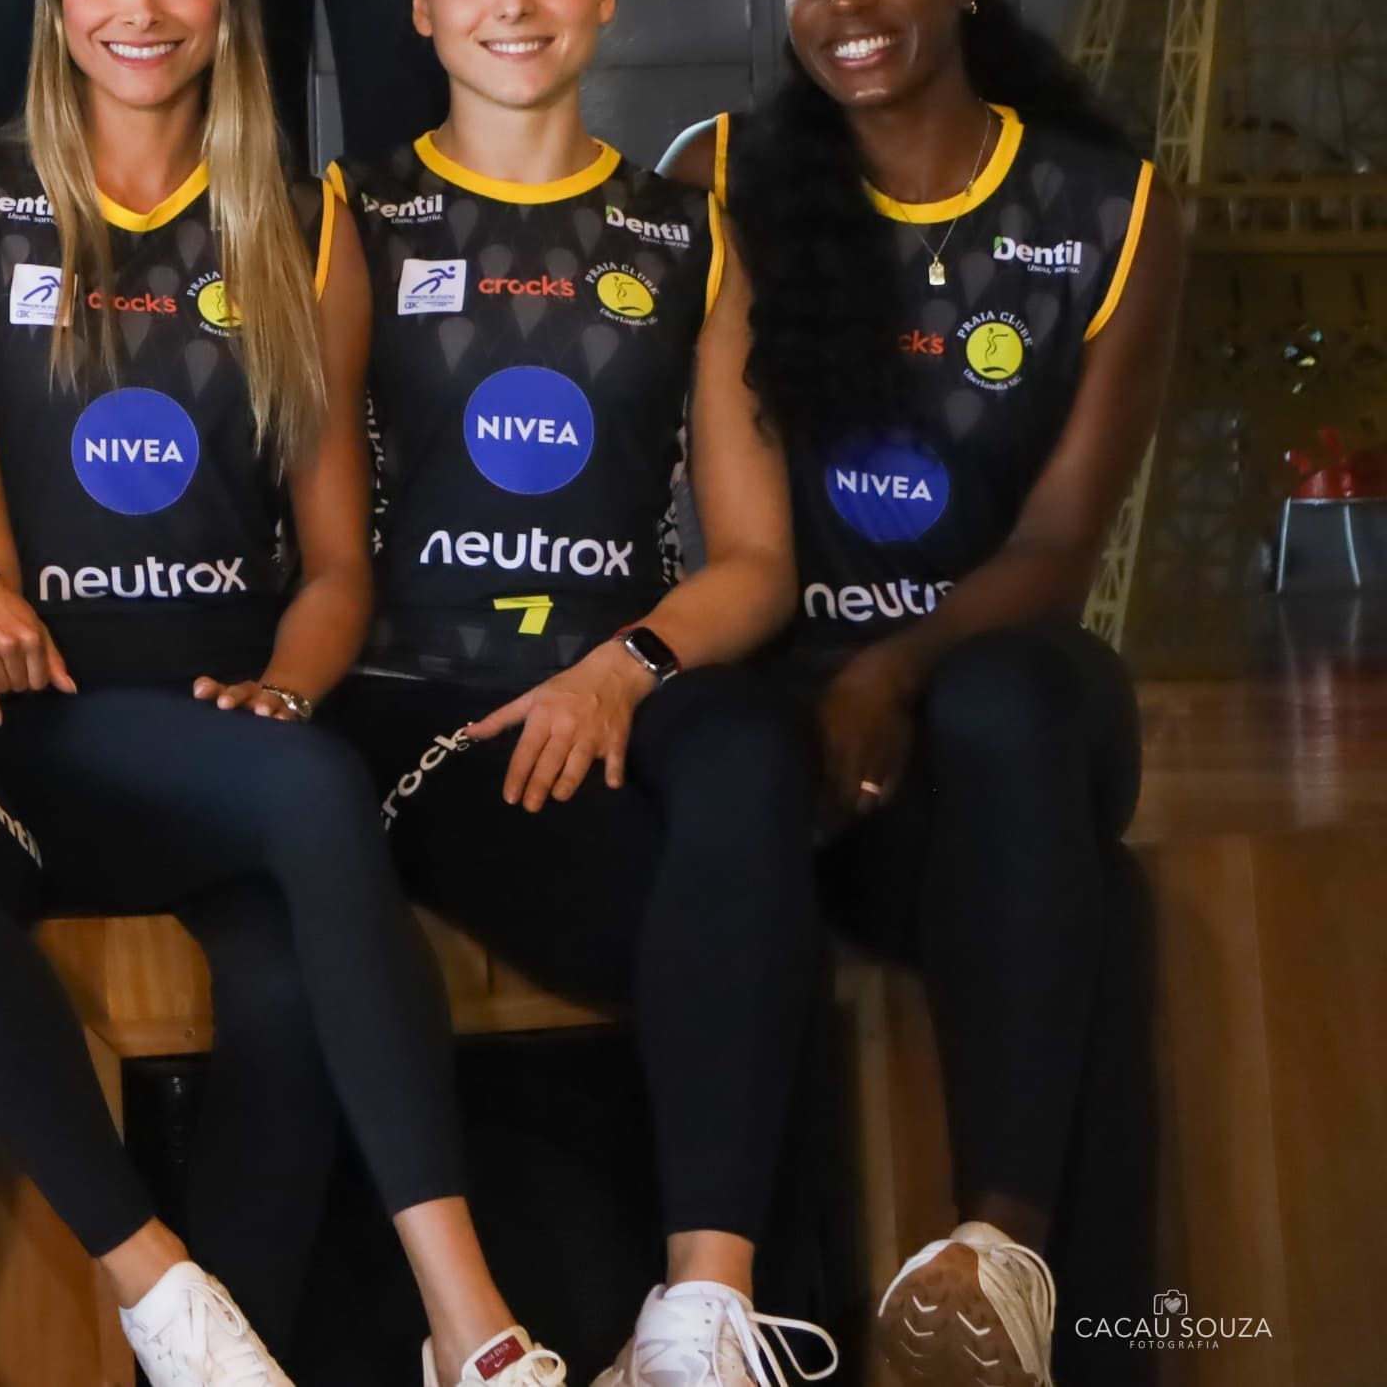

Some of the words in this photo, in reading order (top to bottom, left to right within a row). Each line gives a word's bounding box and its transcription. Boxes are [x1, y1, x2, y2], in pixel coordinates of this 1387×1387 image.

[606, 206, 690, 244] Dentil
[994, 236, 1082, 265] Dentil
[186, 270, 221, 297] PRAIA
[585, 263, 618, 284] PRAIA
[620, 263, 661, 296] CLUBE
[957, 311, 995, 339] PRAIA
[999, 311, 1033, 347] CLUBE
[477, 415, 579, 446] NIVEA
[85, 439, 184, 463] NIVEA
[835, 469, 933, 502] NIVEA
[419, 527, 634, 577] neutrox
[39, 556, 247, 601] neutrox
